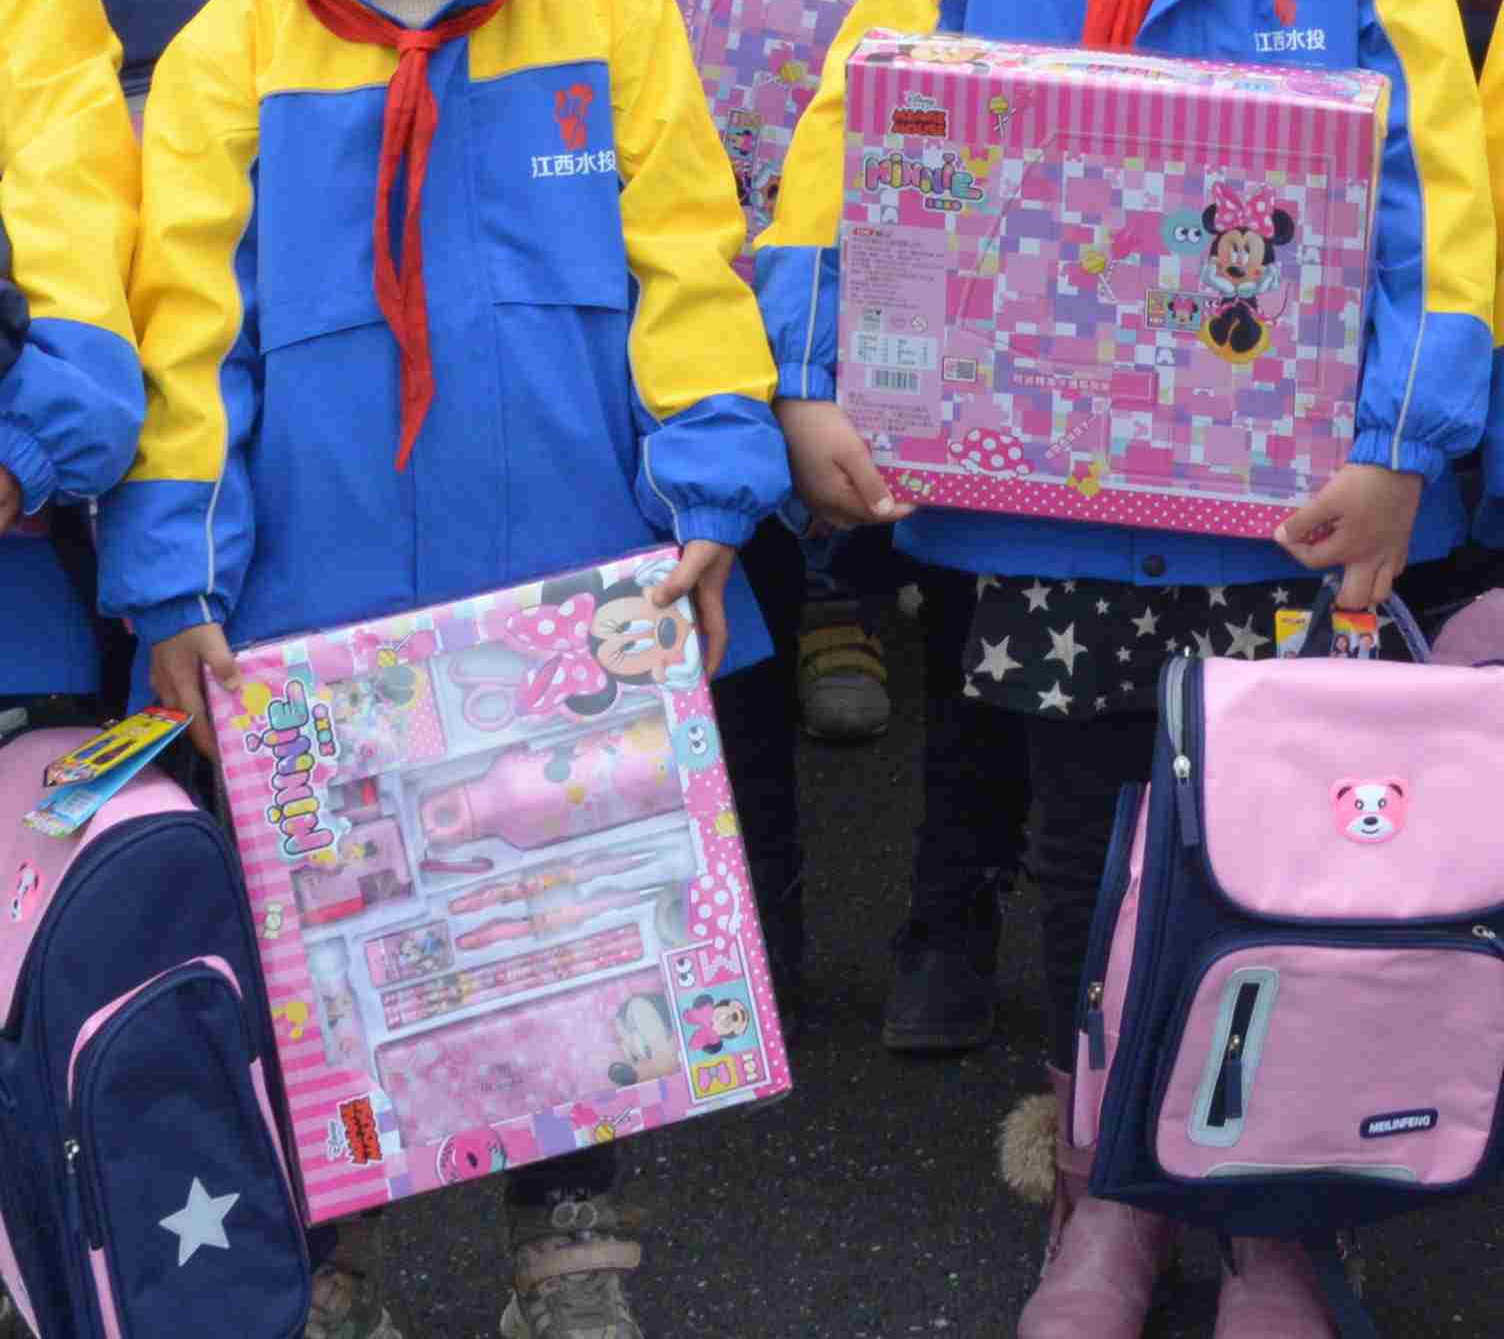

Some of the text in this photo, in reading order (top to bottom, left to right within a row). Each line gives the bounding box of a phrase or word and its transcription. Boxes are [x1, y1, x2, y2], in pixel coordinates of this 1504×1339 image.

[1254, 29, 1327, 52] 江西水投
[530, 149, 617, 180] 江西水投
[246, 679, 336, 857] MINNIE
